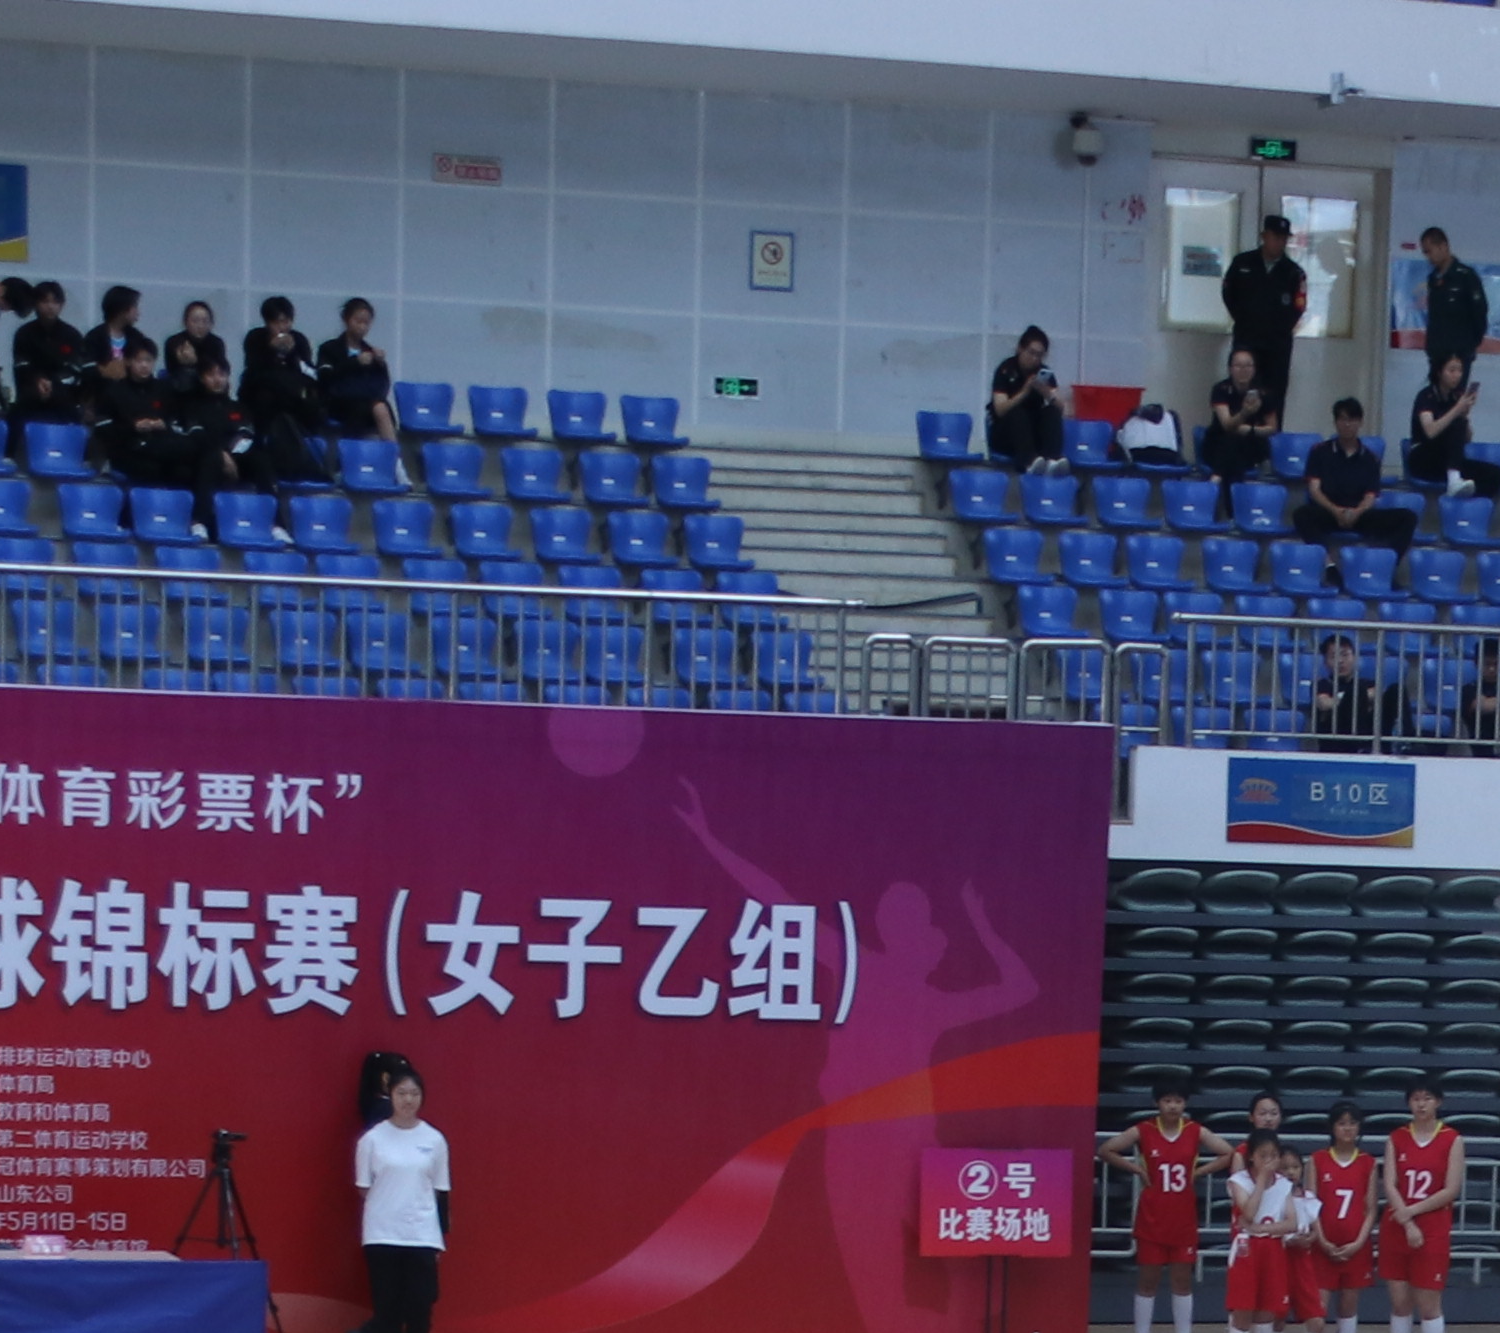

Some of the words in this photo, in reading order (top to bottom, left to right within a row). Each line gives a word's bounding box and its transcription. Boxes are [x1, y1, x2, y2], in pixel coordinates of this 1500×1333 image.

[1158, 1163, 1187, 1193] 13
[1405, 1169, 1432, 1200] 12
[1335, 1188, 1354, 1219] 7
[938, 1207, 1052, 1242] 比赛场地
